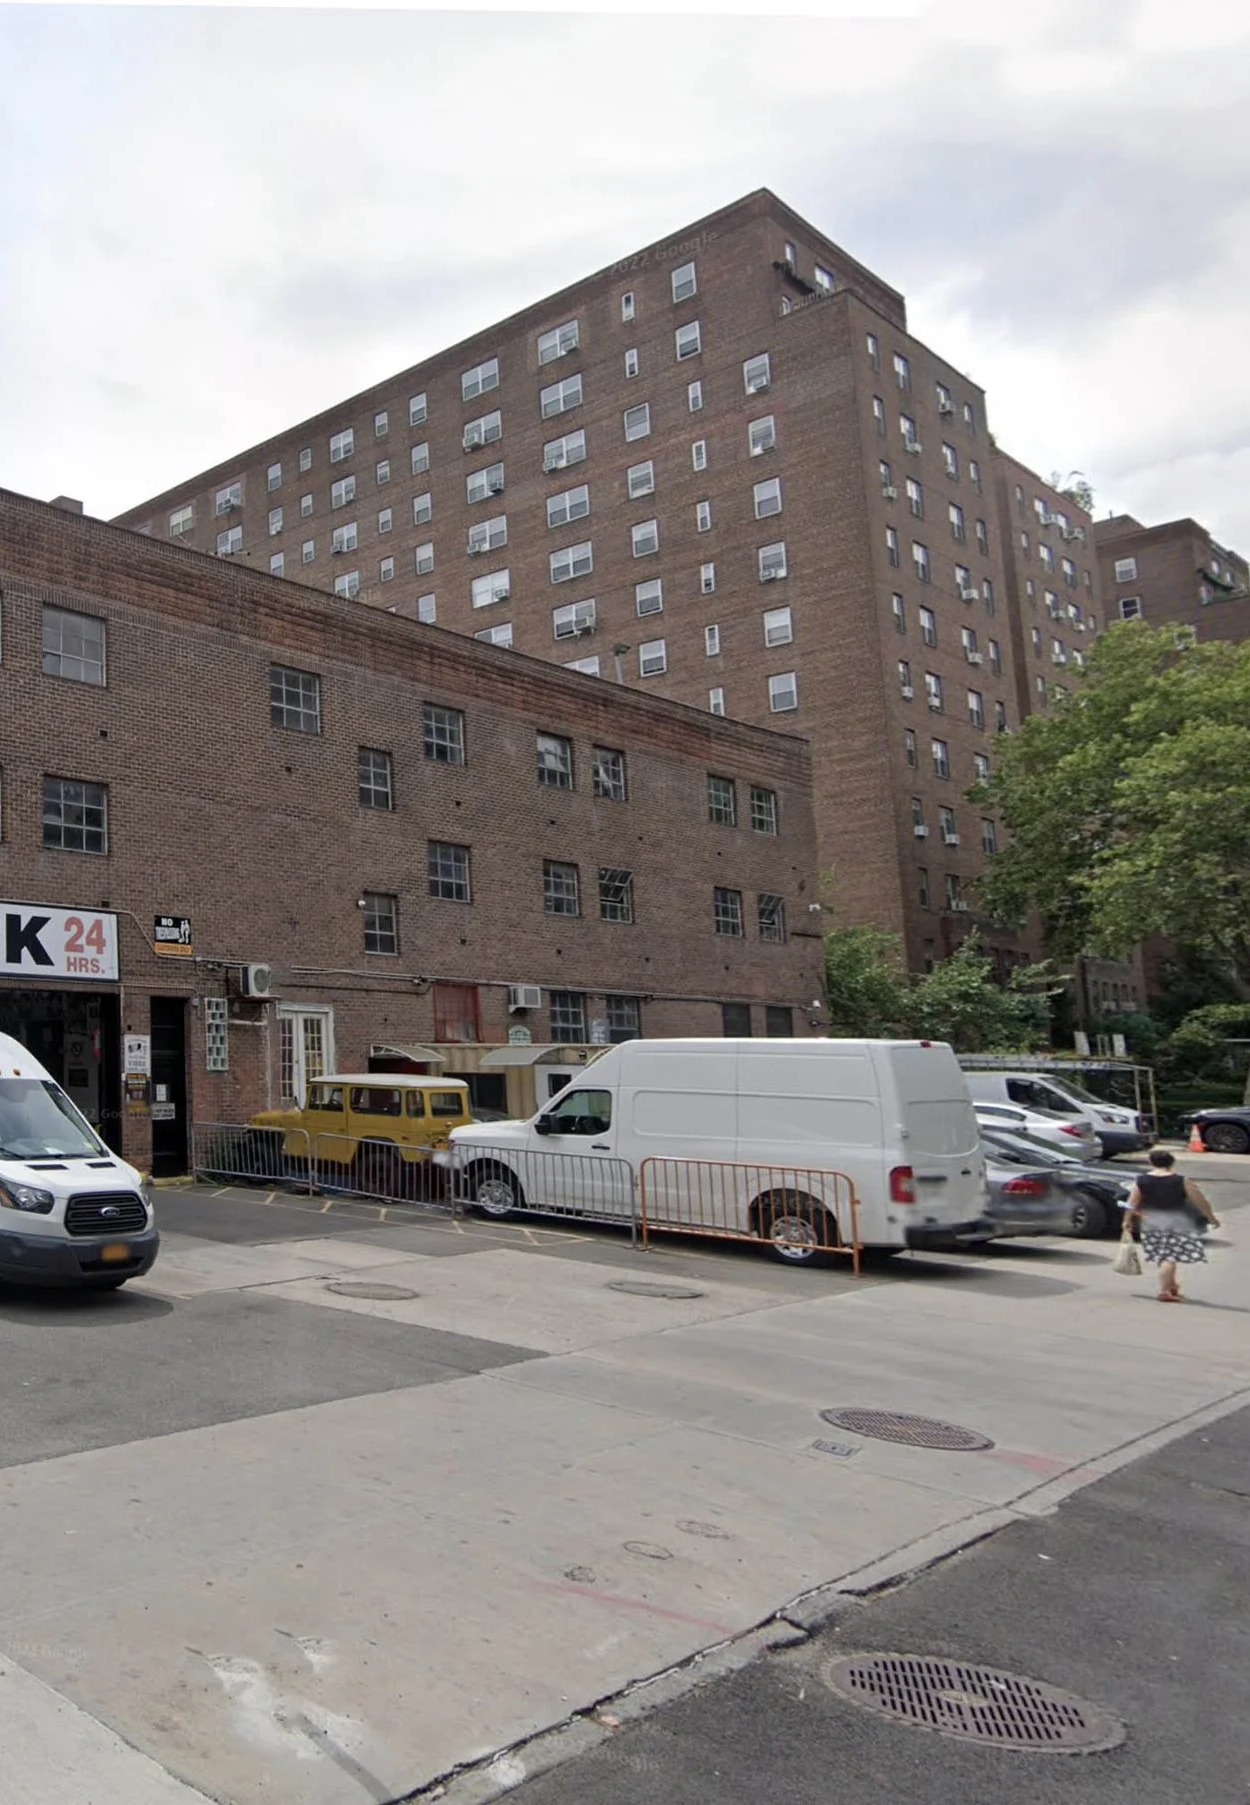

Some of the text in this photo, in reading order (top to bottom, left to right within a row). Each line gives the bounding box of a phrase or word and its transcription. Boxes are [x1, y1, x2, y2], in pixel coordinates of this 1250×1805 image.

[161, 917, 174, 926] NO
[63, 916, 107, 955] 24
[66, 956, 106, 975] HRS.
